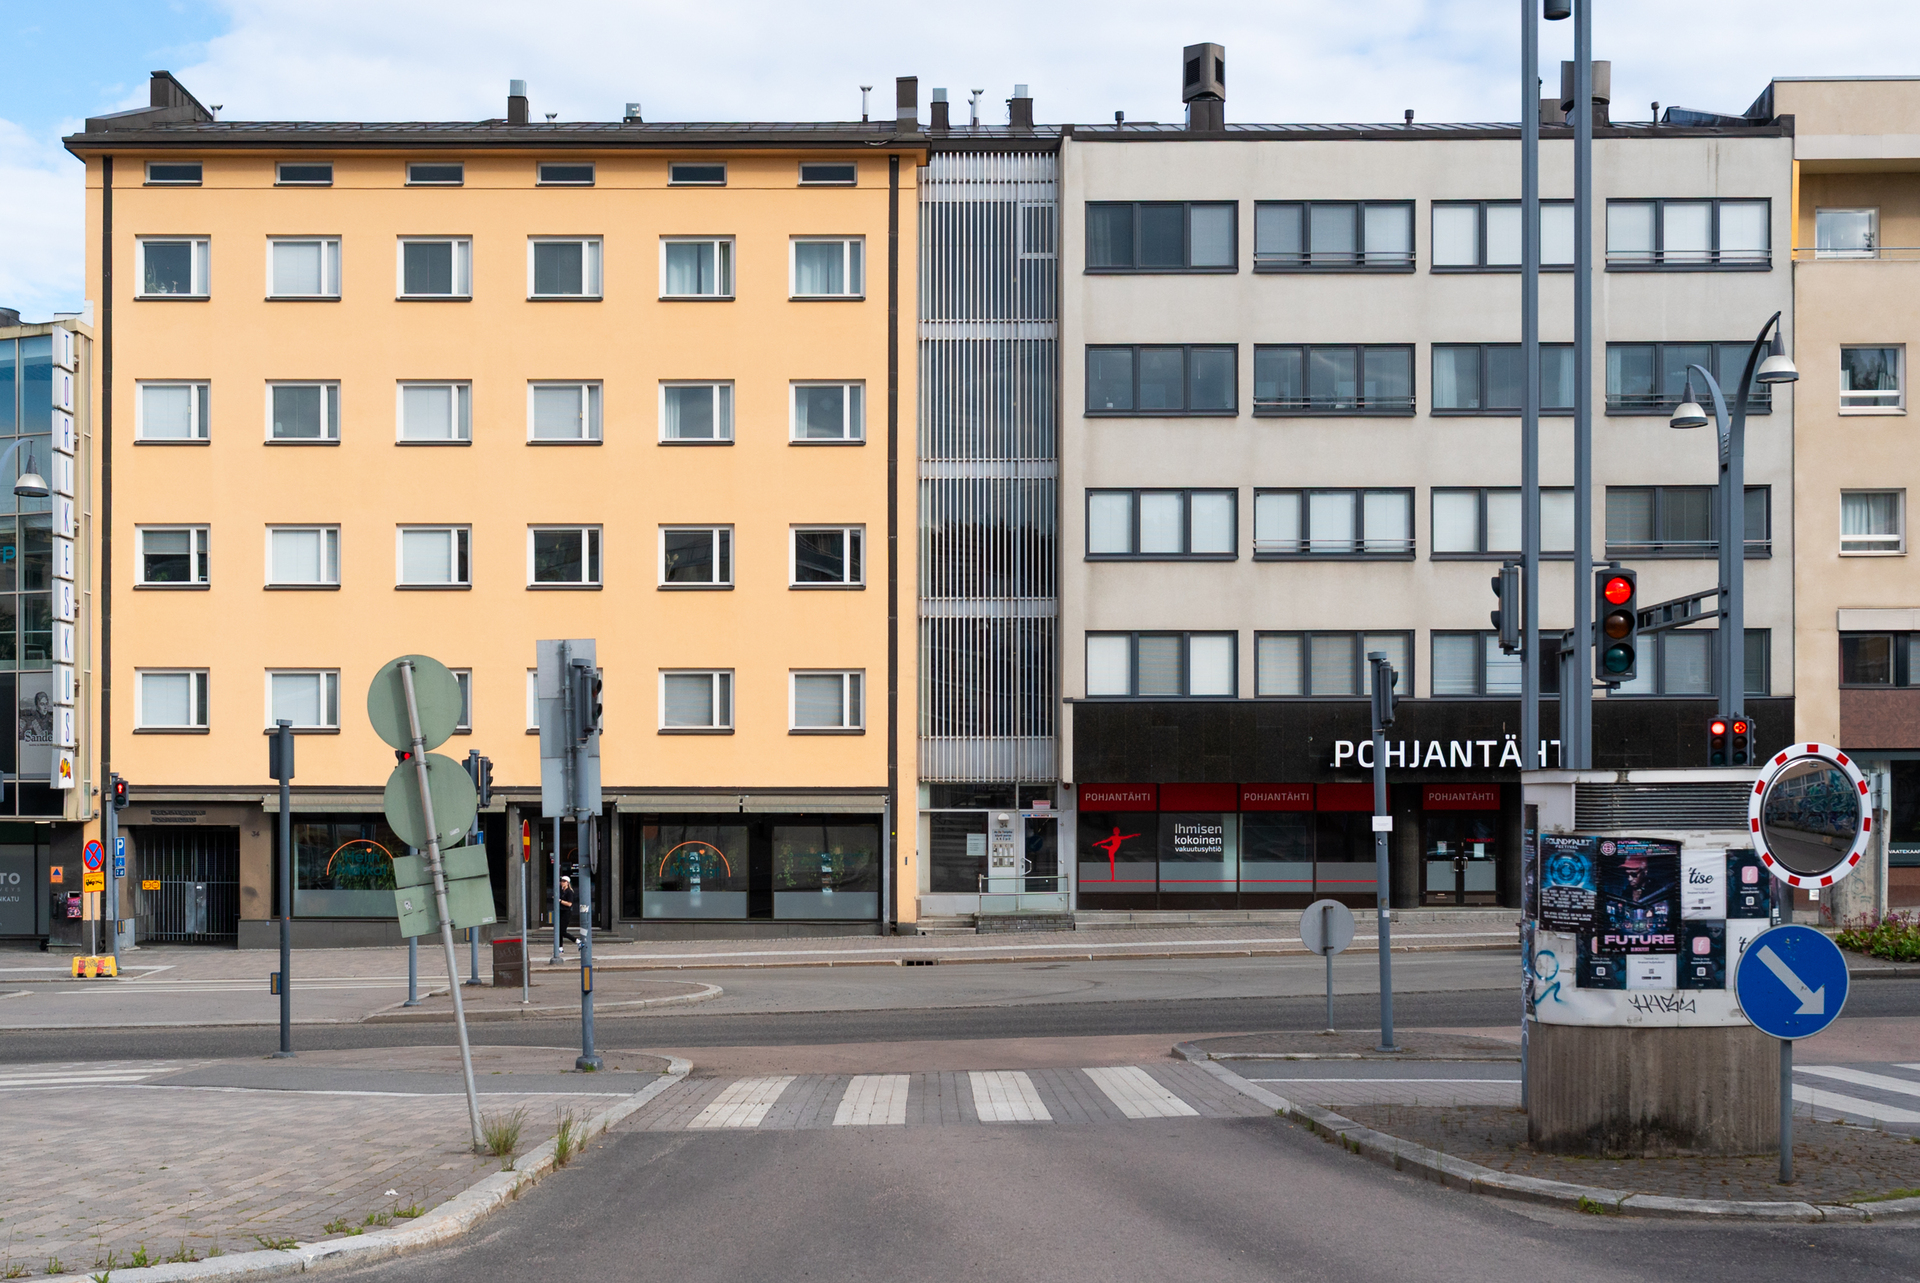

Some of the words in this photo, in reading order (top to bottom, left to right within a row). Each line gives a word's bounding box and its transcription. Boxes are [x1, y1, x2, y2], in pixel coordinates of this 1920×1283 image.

[1085, 791, 1151, 801] POHJANTÄHTI
[1244, 791, 1310, 801] POHJANTÄHTI
[1428, 791, 1494, 801] POHJANTÄHTI
[1174, 823, 1222, 834] Ihmisen
[1174, 835, 1222, 845] kokoinen
[116, 838, 124, 856] P
[1174, 846, 1222, 854] vakuutusyhtiö
[344, 848, 381, 863] Helin
[336, 863, 388, 876] Matkat
[1604, 934, 1675, 945] FUTURE
